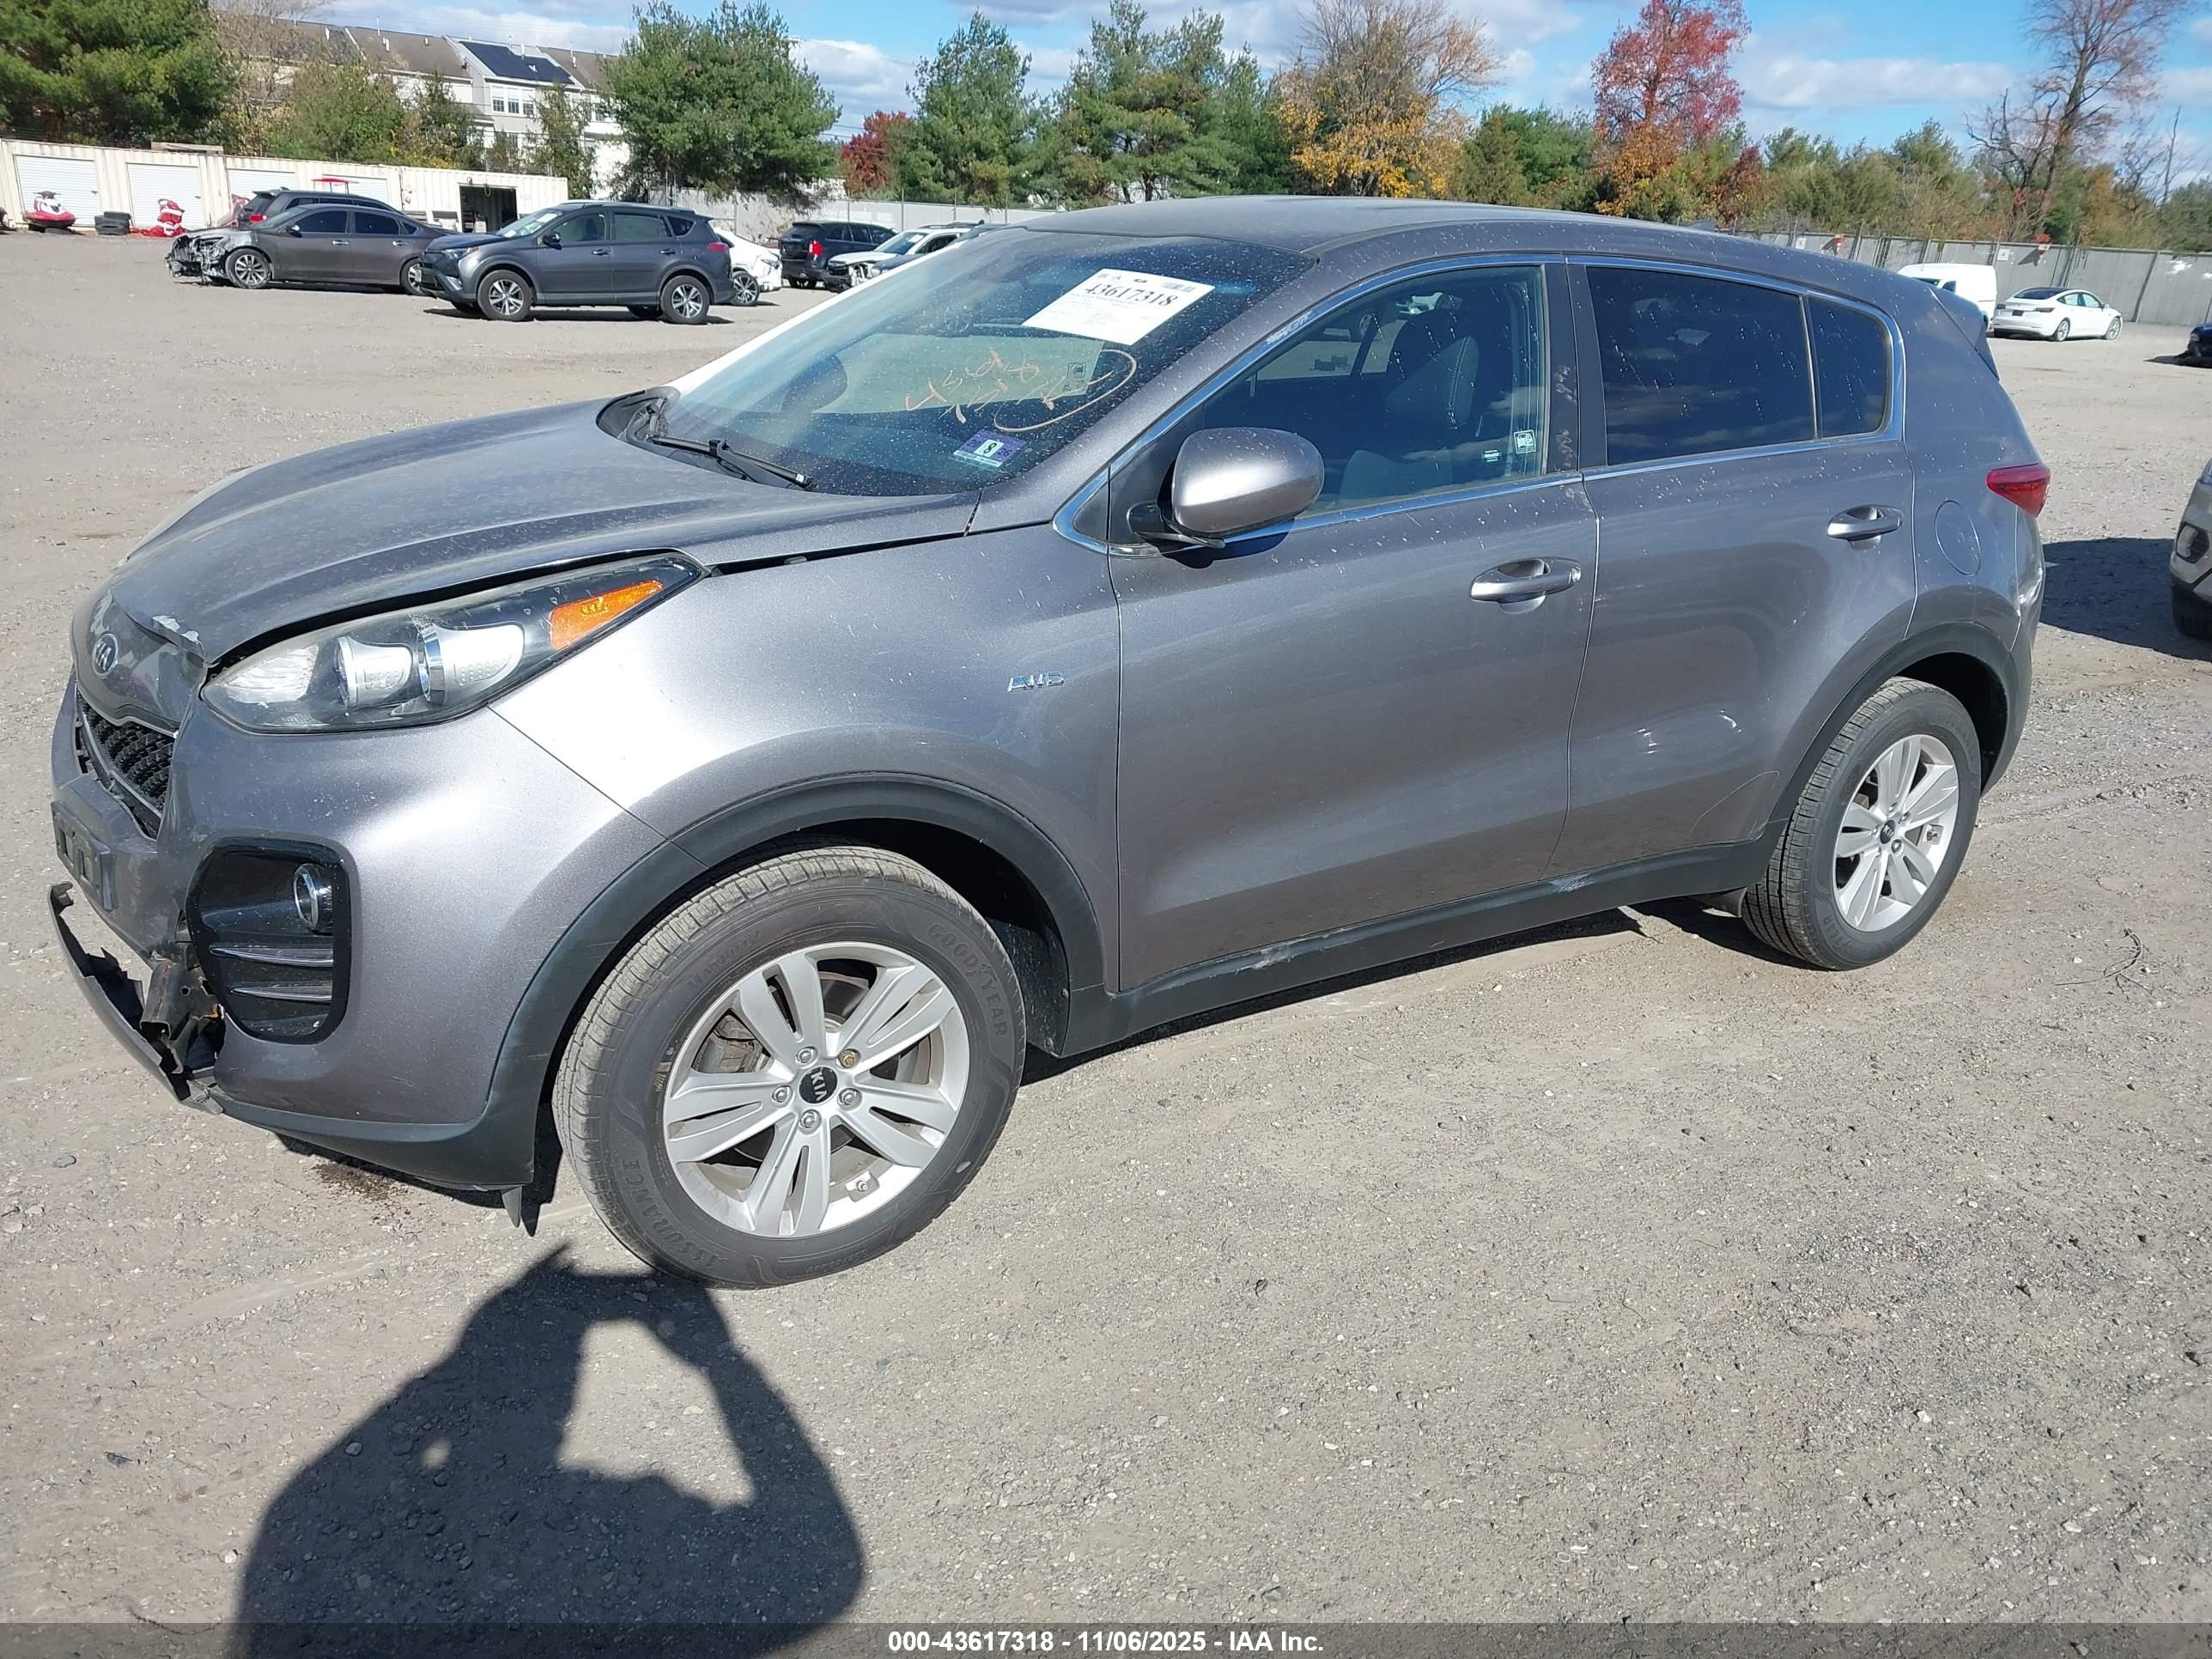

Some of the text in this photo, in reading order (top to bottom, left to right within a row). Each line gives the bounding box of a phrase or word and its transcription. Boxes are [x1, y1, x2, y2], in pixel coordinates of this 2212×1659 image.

[1085, 283, 1179, 307] 43617318
[983, 442, 998, 454] 8
[1006, 672, 1065, 693] AWD
[927, 922, 1009, 1037] GOODYEAR
[811, 1070, 828, 1102] KIA
[622, 1158, 729, 1268] ASSURANCE
